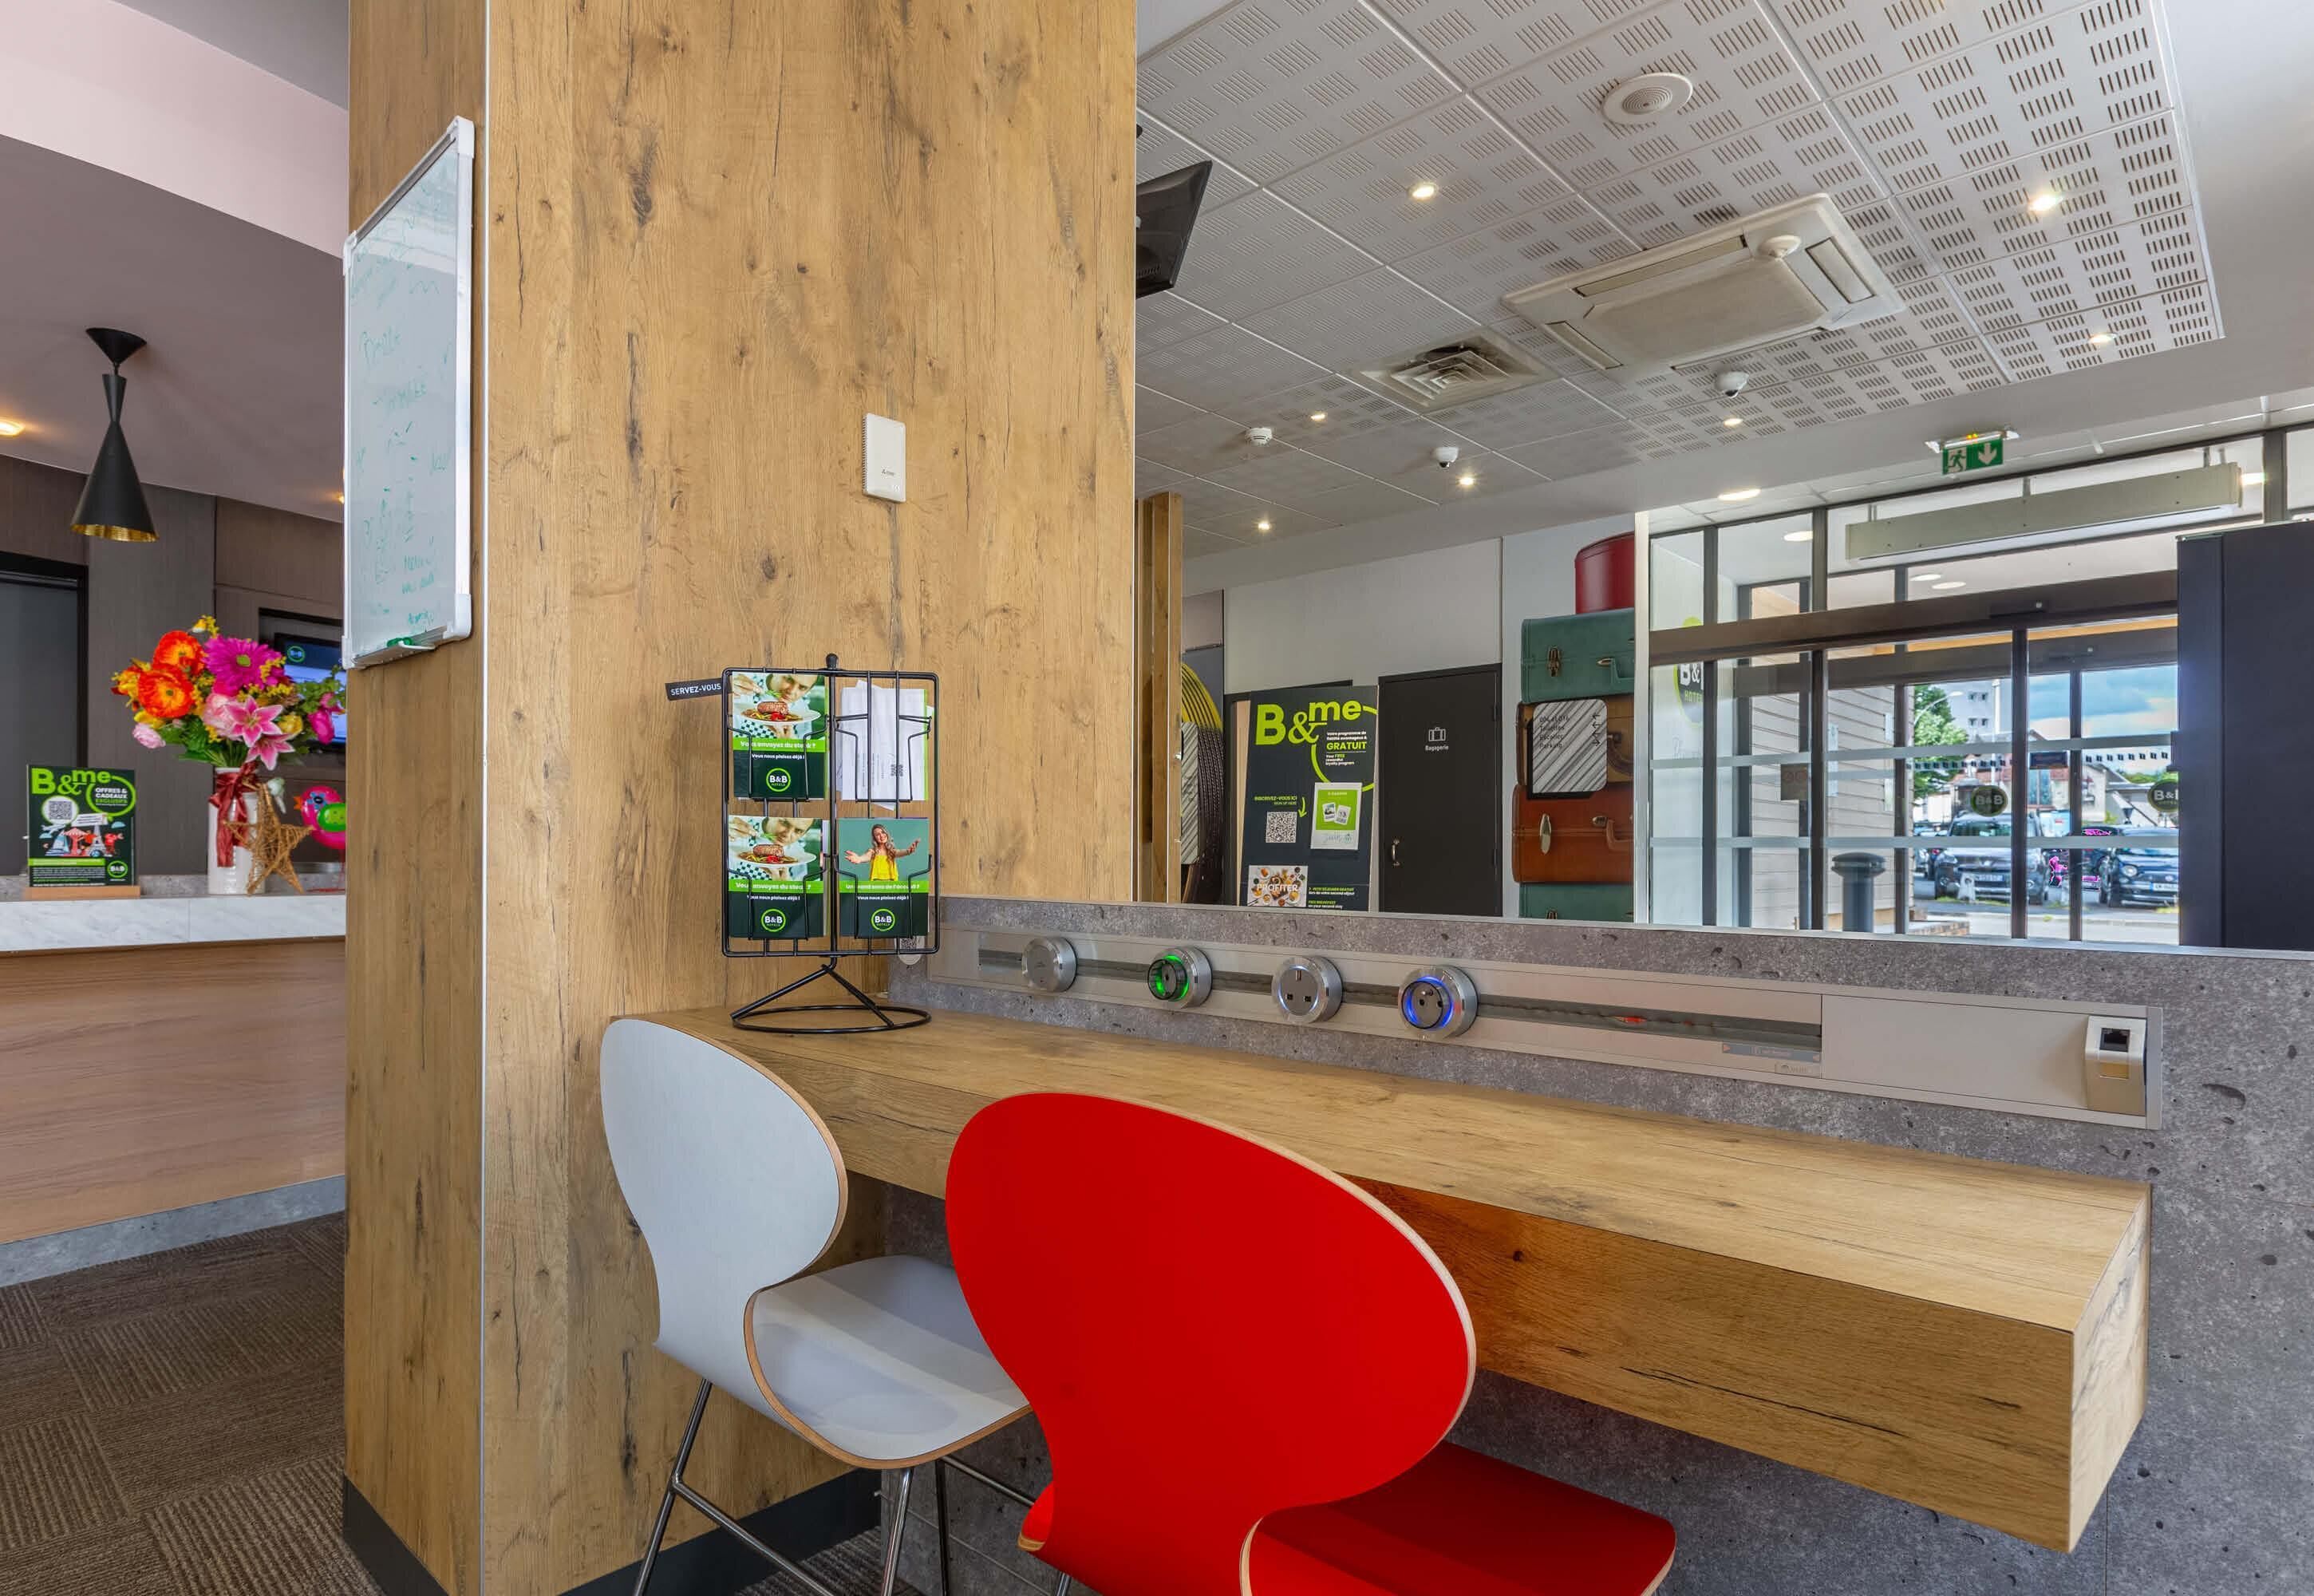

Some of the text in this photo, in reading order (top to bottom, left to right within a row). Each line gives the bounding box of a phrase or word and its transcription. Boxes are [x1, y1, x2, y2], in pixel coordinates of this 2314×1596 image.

[1680, 661, 1704, 690] B&
[670, 683, 722, 696] SERVEZ-VOUS
[1326, 741, 1368, 750] GRATUIT
[1257, 883, 1299, 892] PROFITER
